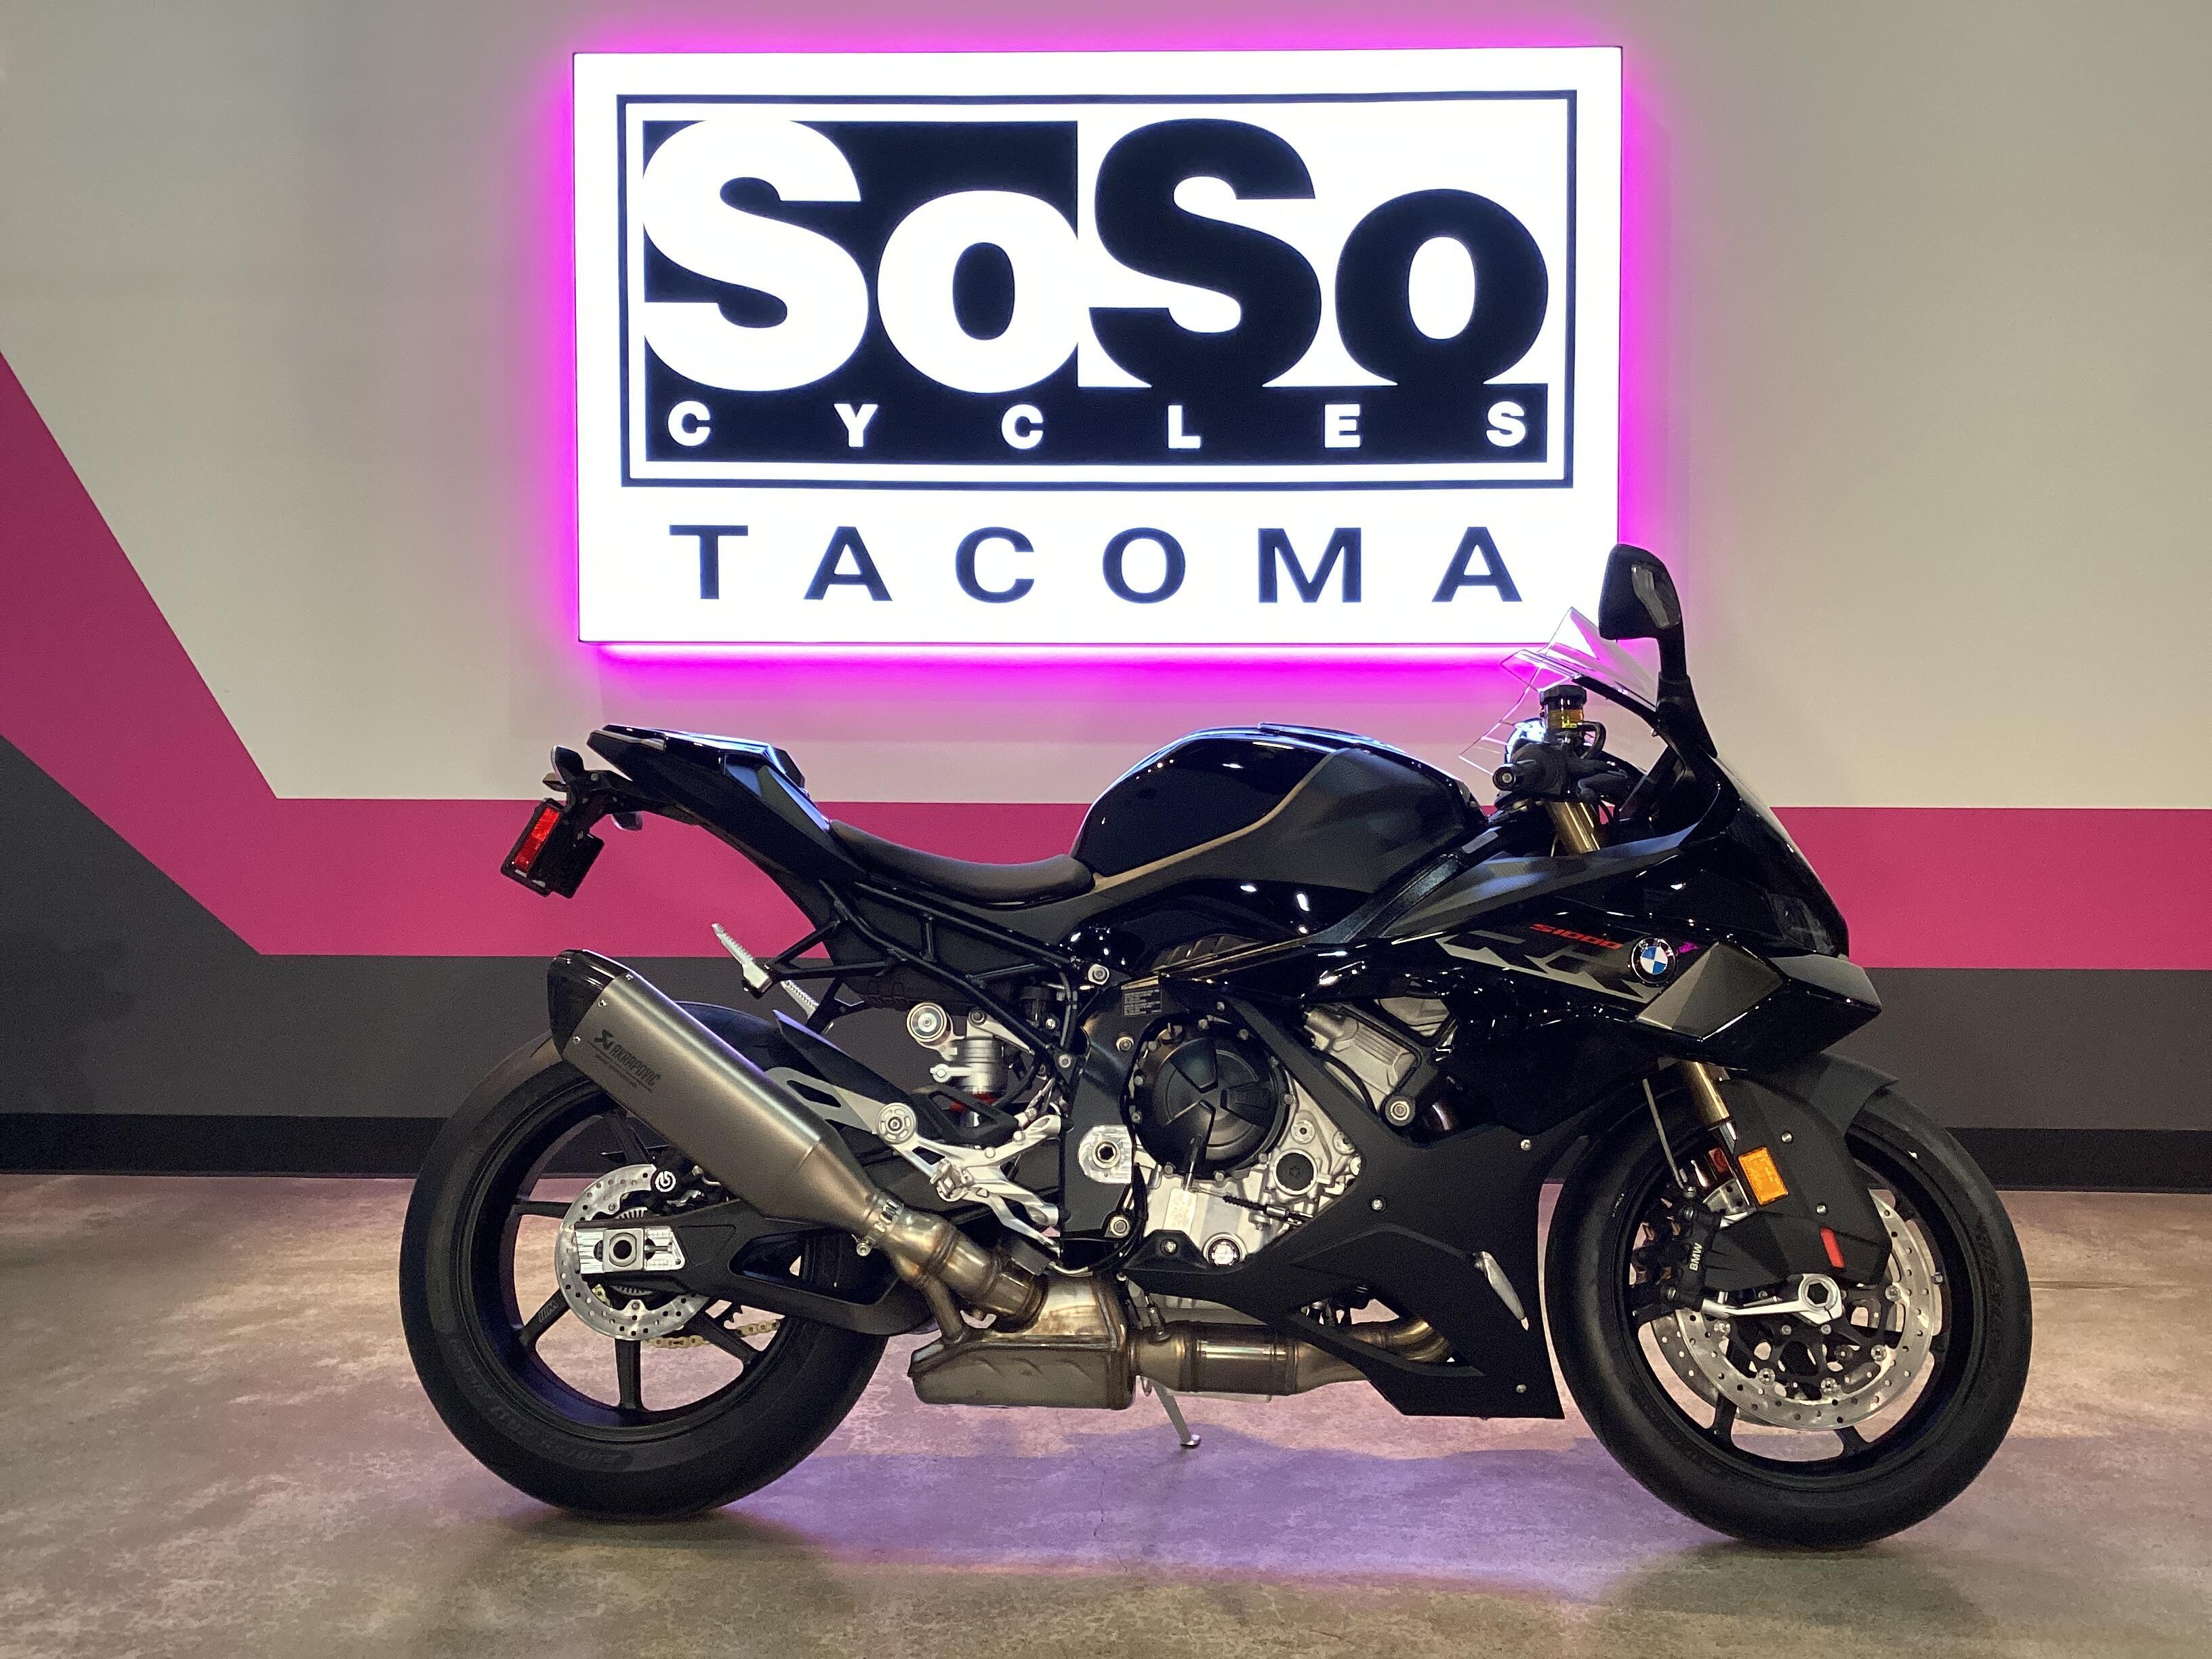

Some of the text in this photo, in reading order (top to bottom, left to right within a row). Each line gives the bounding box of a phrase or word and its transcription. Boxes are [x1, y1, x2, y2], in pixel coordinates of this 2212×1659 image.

[643, 117, 1549, 394] SoSo
[668, 400, 1526, 449] CYCLES
[670, 524, 1523, 603] TACOMA
[1529, 924, 1625, 949] S1000
[1689, 1242, 1702, 1271] BMW
